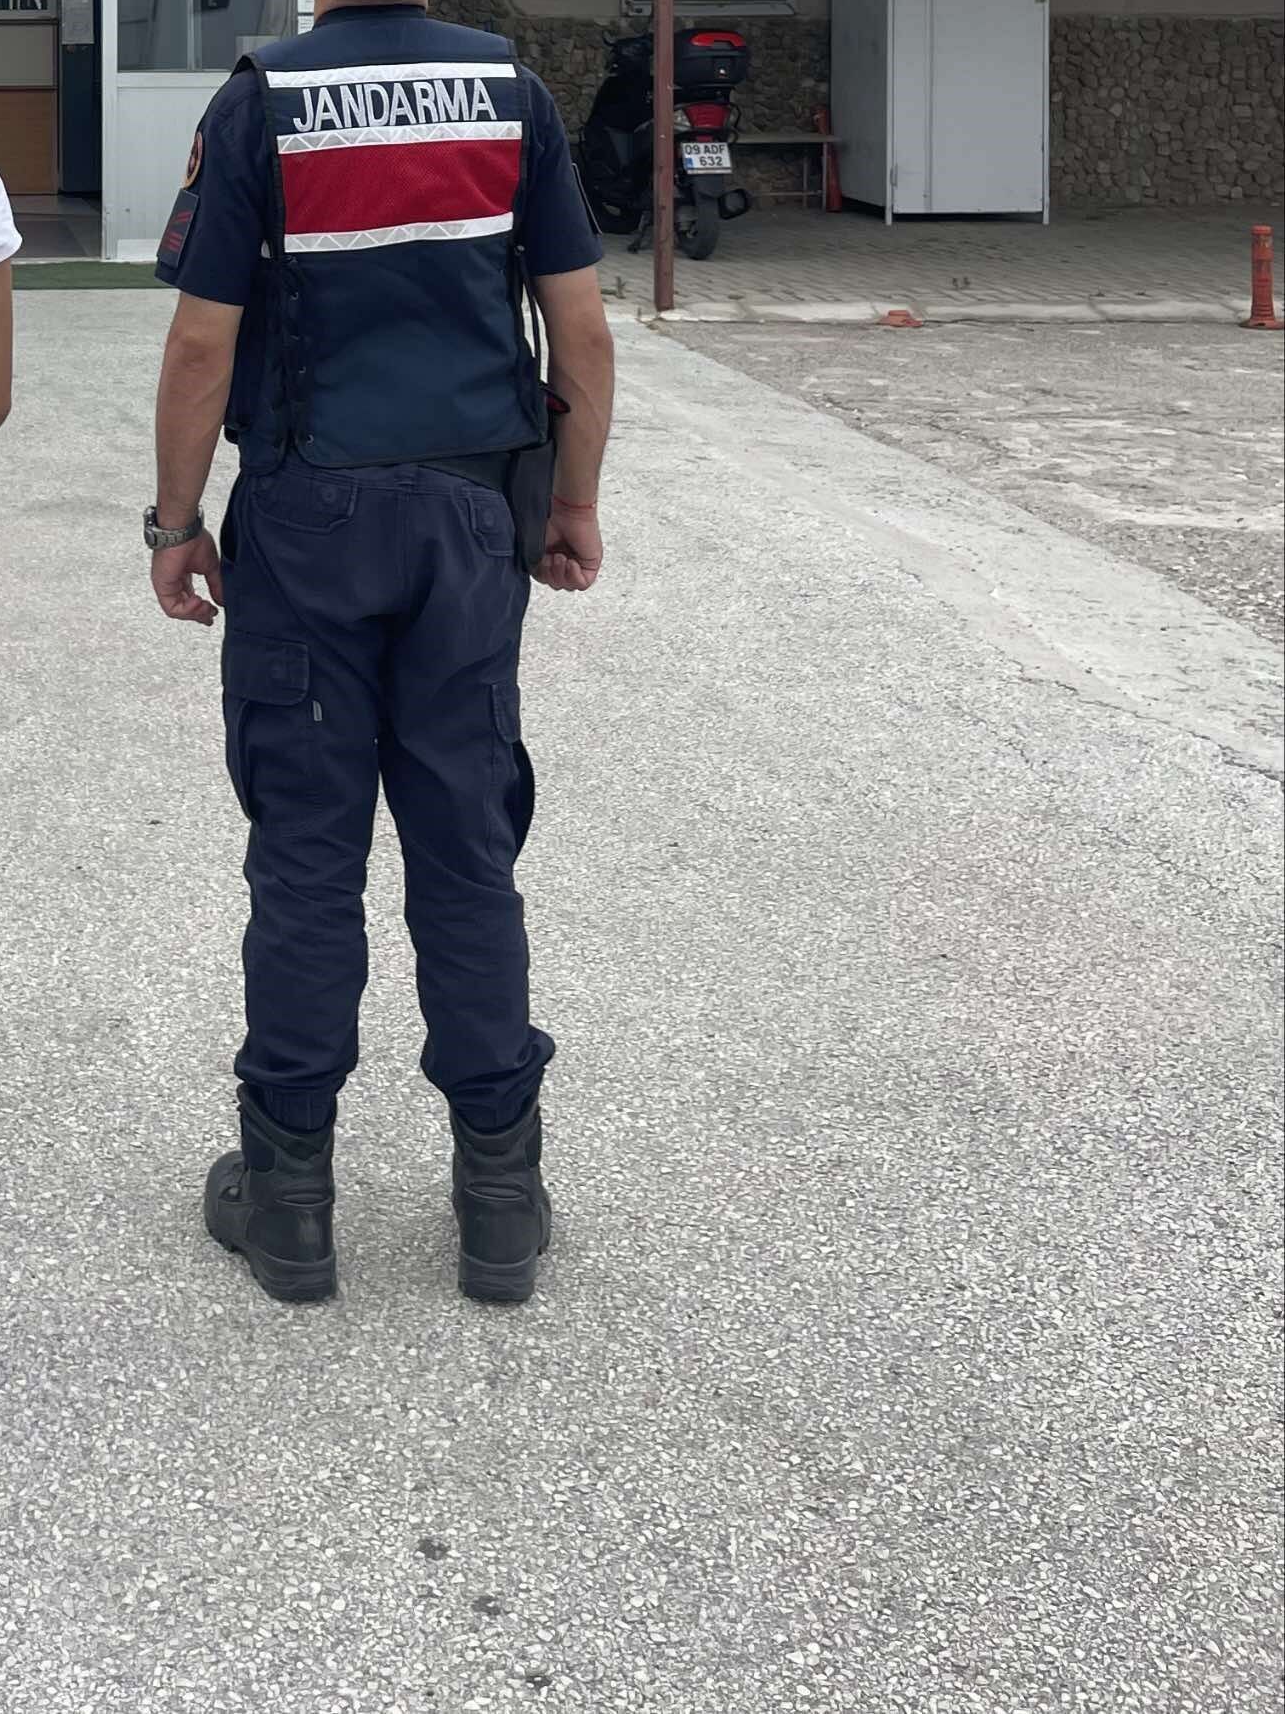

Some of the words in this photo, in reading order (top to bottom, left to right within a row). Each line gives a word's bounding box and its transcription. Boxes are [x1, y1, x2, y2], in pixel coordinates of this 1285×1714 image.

[293, 78, 497, 132] JANDARMA
[684, 144, 701, 155] 09
[704, 144, 726, 154] ADF
[699, 156, 723, 167] 632
